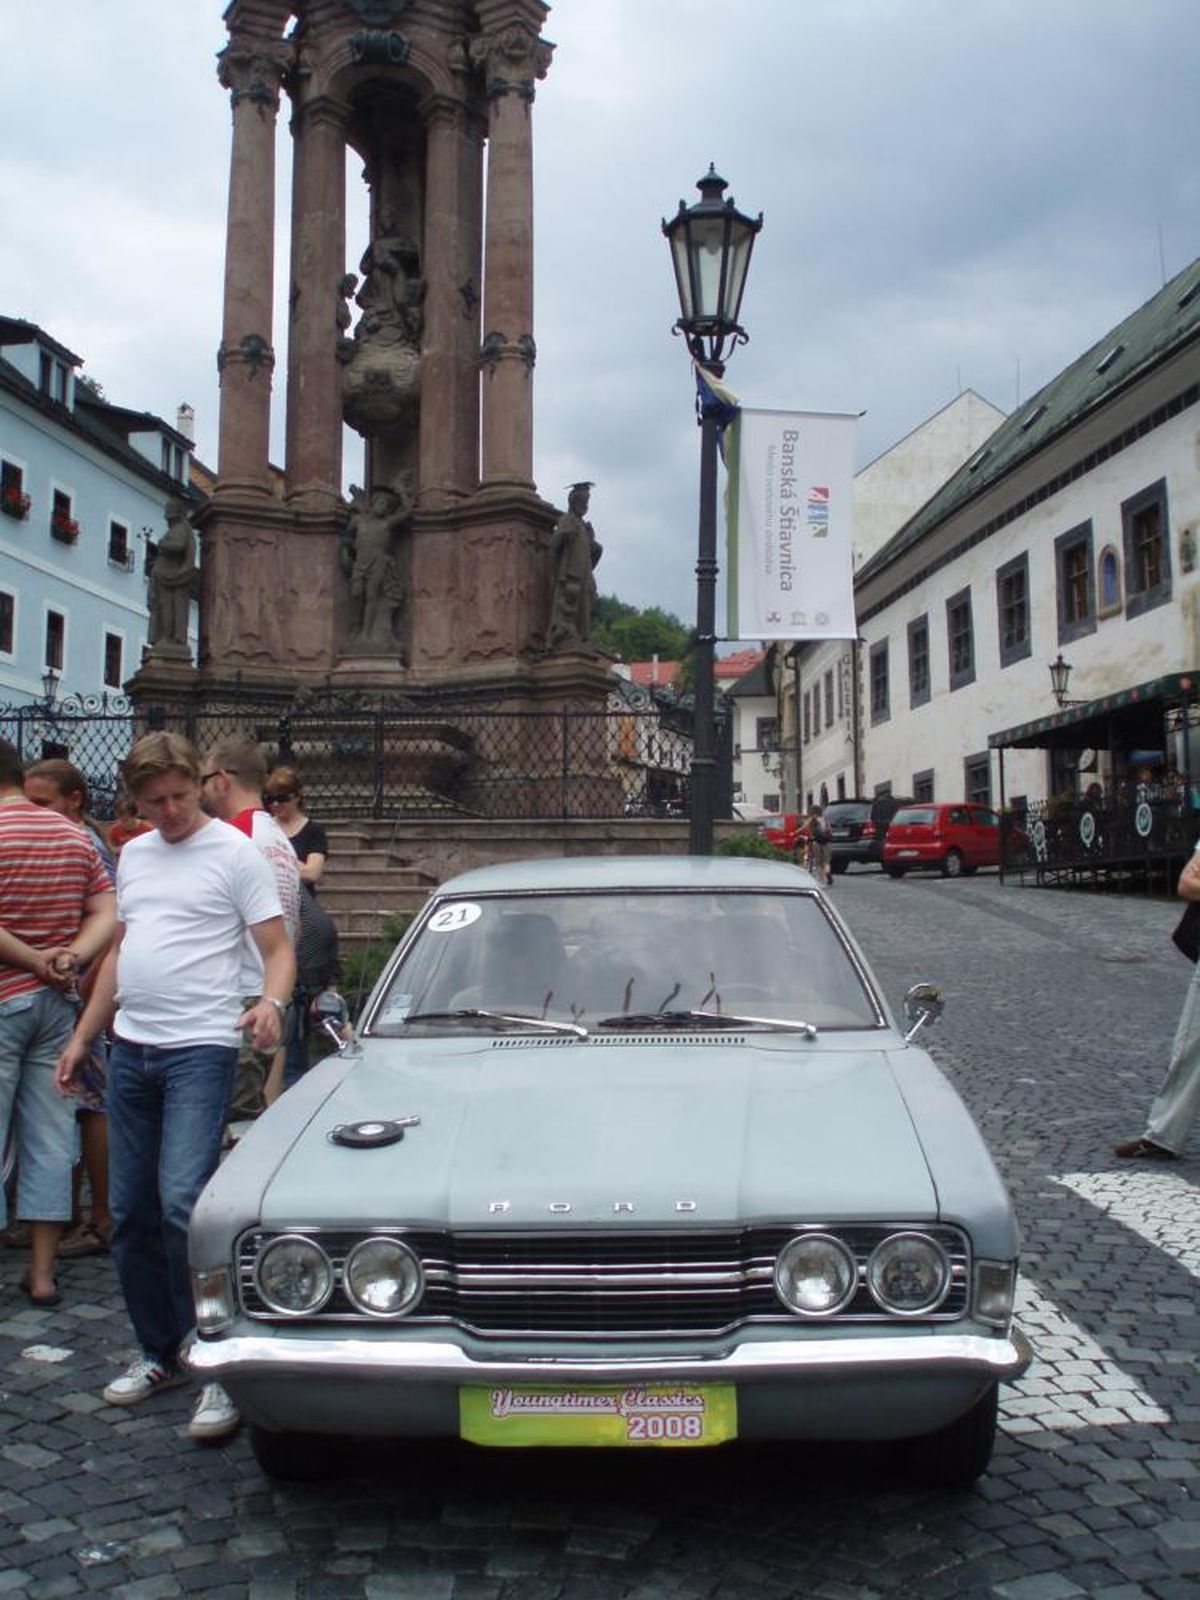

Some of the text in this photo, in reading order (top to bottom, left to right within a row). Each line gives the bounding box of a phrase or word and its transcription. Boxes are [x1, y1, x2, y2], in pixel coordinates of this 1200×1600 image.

[779, 429, 801, 592] Banská Štiavnica
[438, 909, 467, 926] 21
[487, 1201, 698, 1213] FORD
[491, 1389, 705, 1418] Youngtimer Classics
[628, 1416, 704, 1440] 2008
